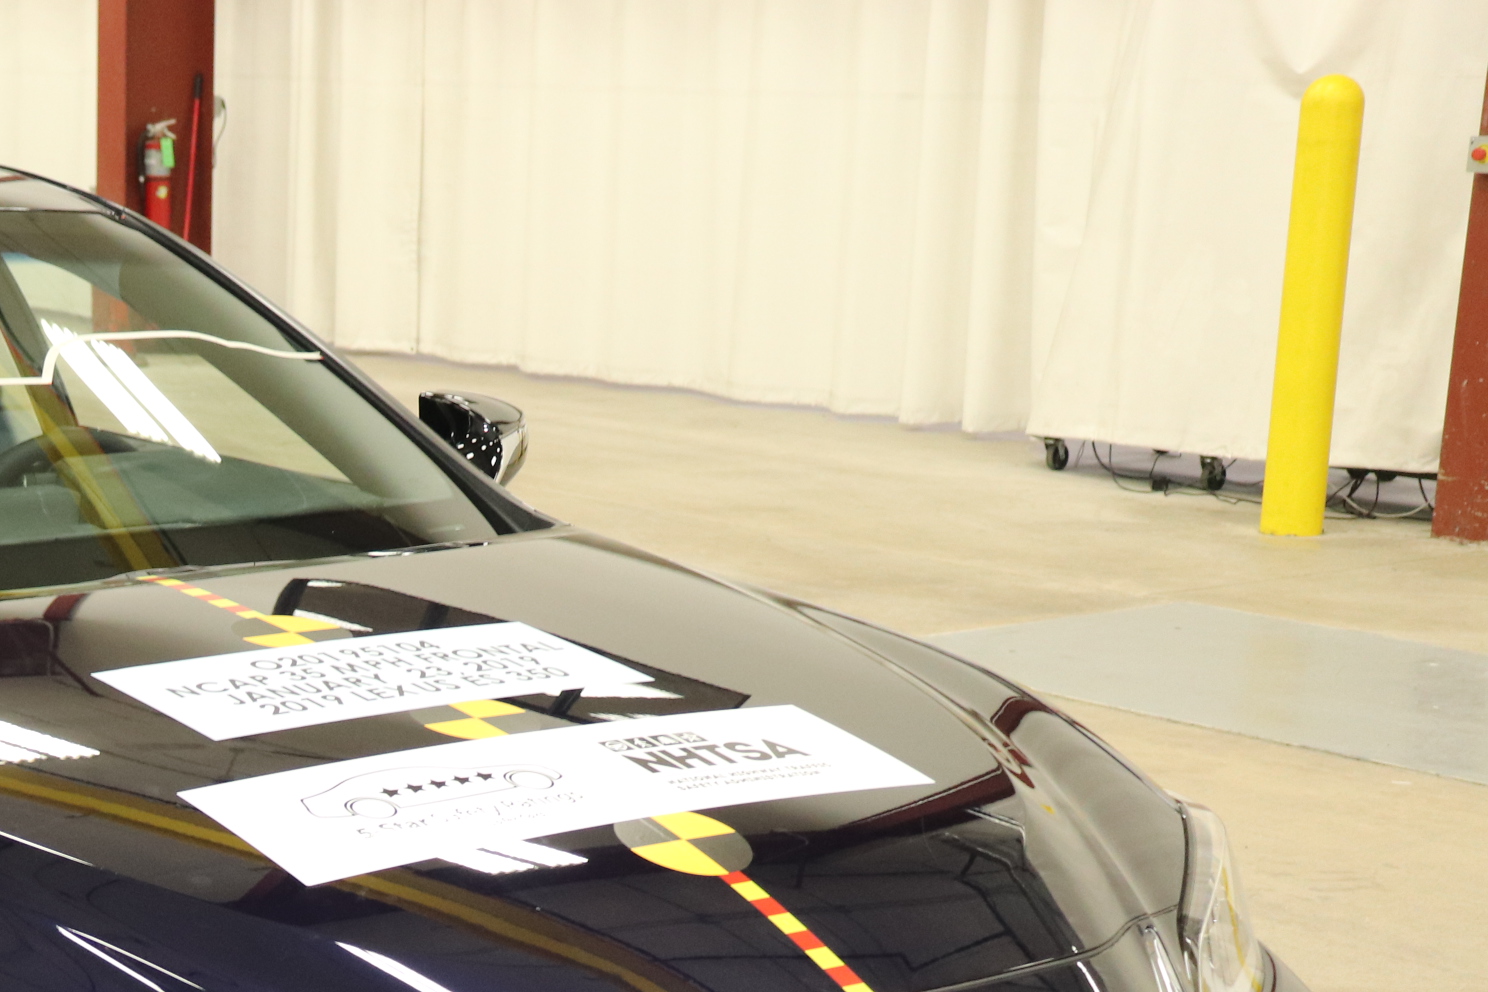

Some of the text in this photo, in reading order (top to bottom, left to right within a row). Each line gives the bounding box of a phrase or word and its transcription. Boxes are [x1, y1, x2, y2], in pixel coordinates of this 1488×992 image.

[166, 641, 564, 698] NCAP 35 MPH FRONTAL
[227, 673, 388, 705] JANUARY
[463, 655, 541, 672] 2019
[259, 666, 570, 716] 2019 LEXUS ES 350
[621, 738, 812, 774] NHTSA
